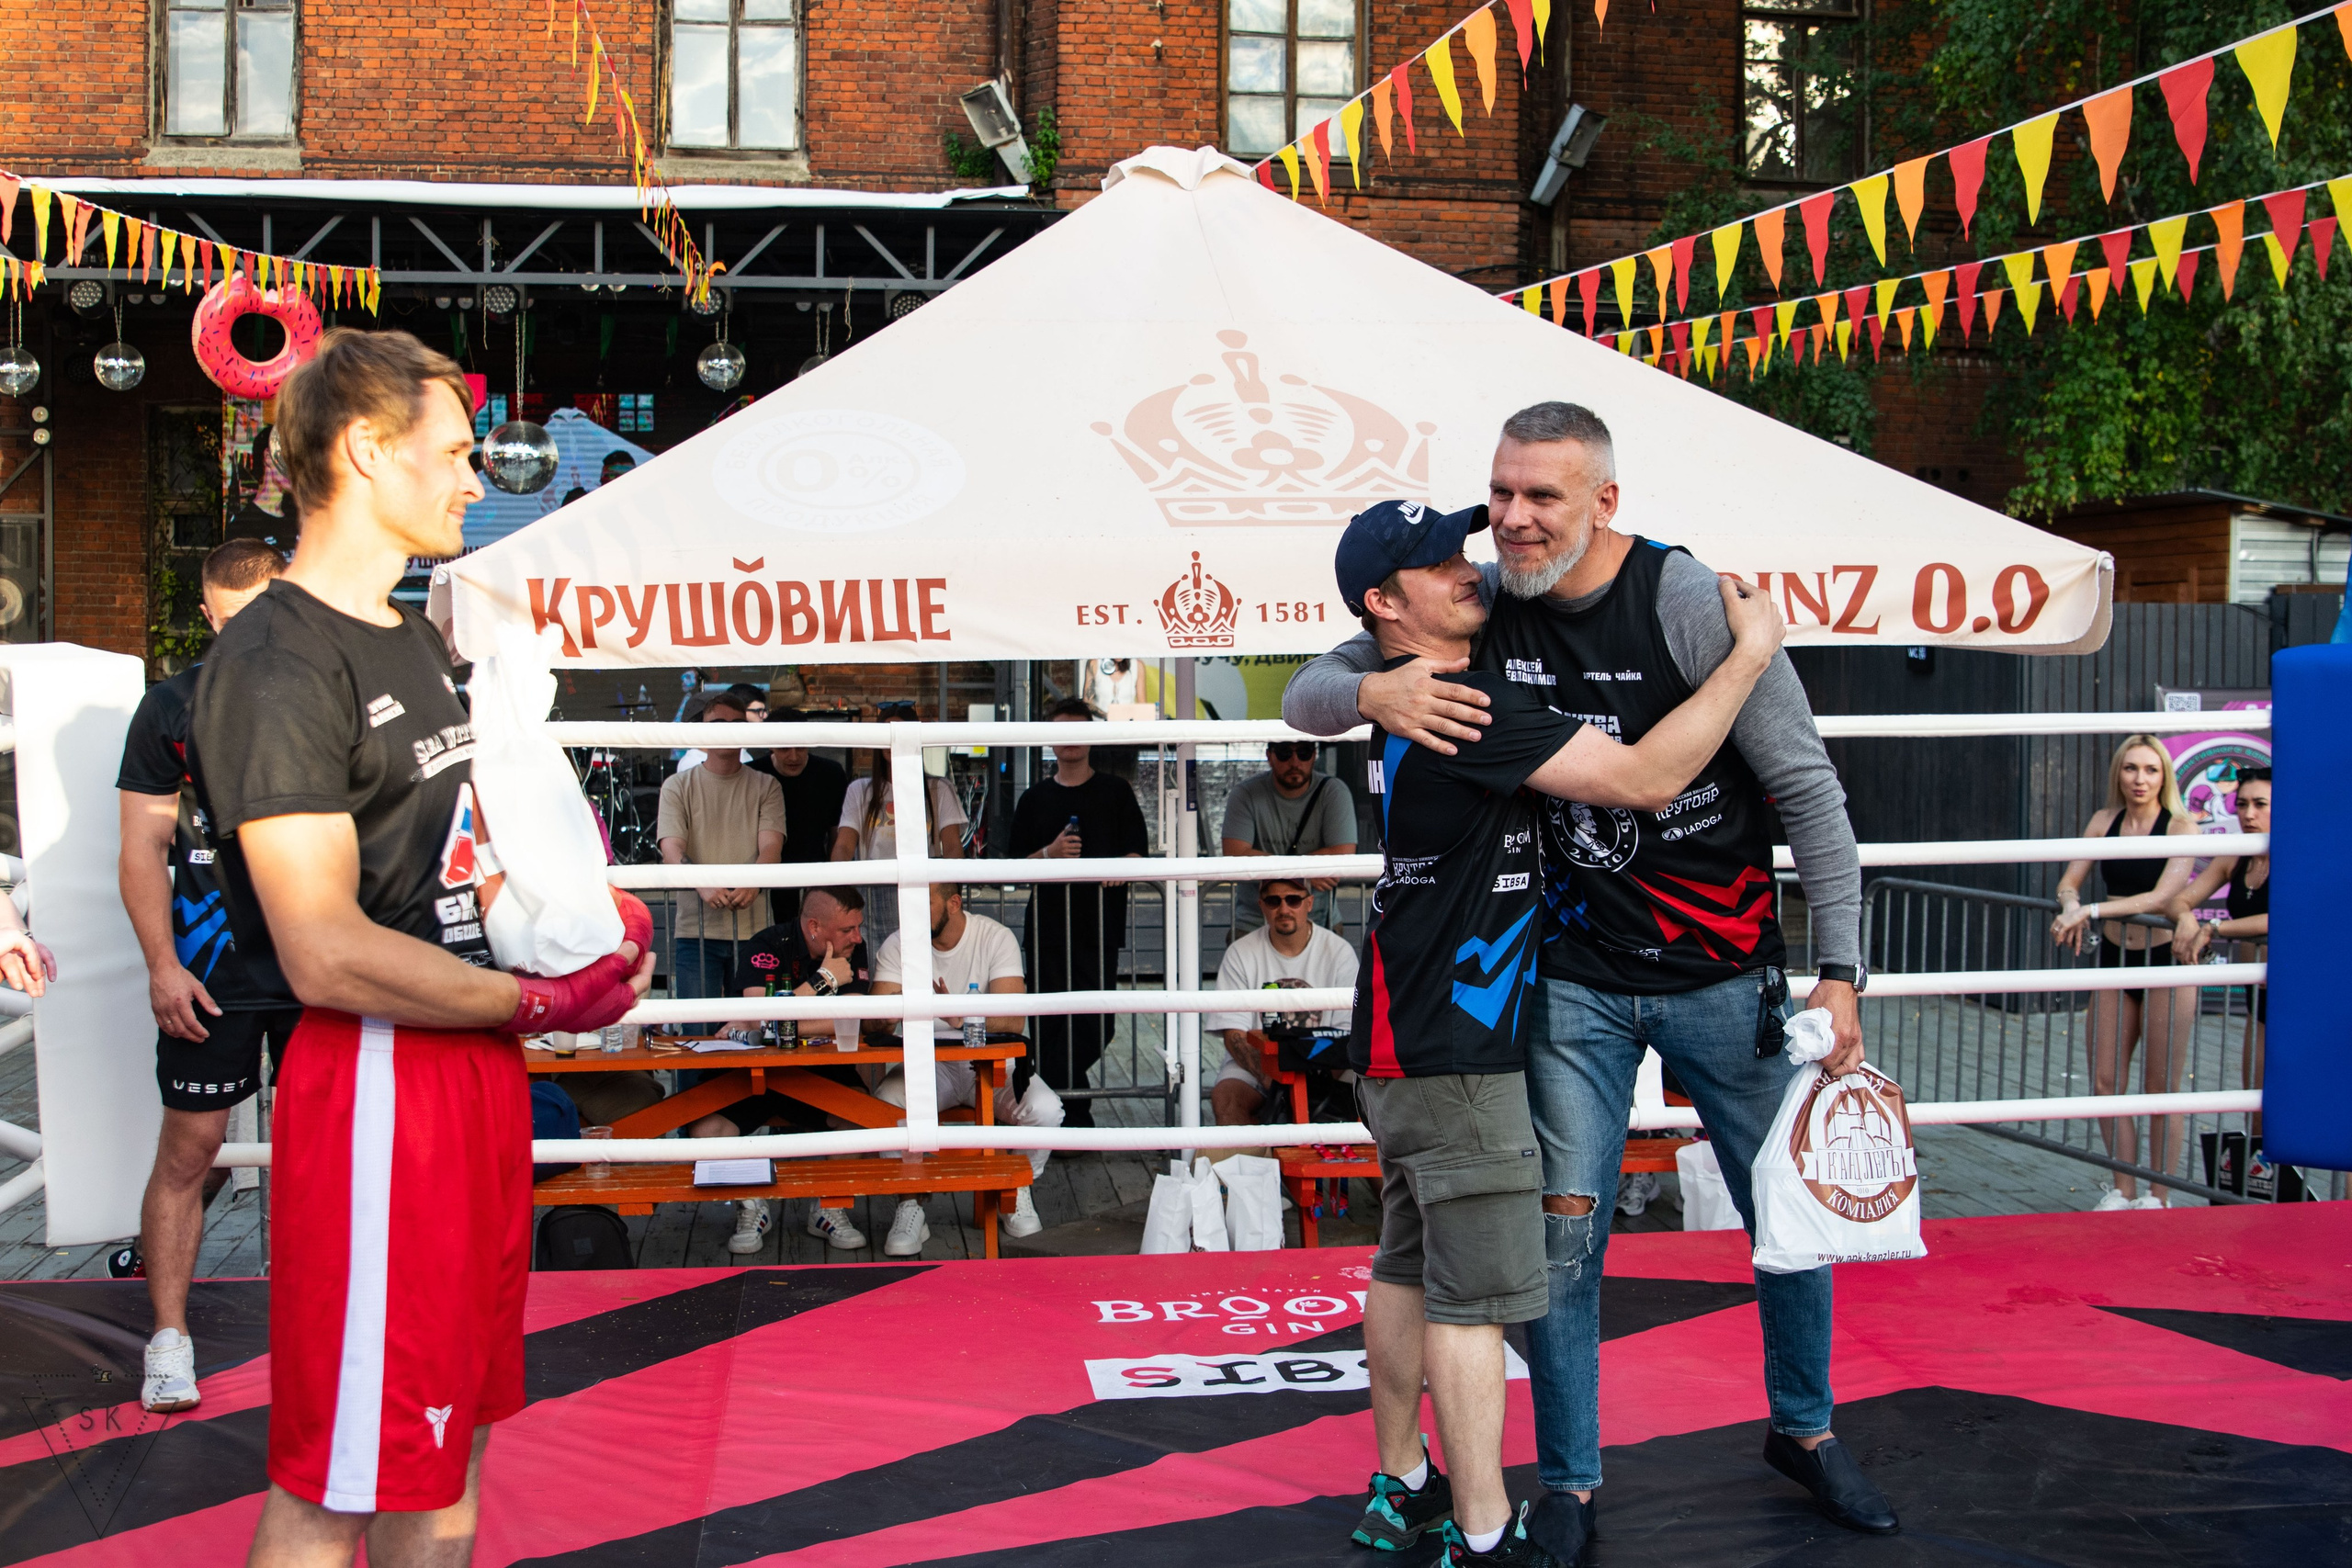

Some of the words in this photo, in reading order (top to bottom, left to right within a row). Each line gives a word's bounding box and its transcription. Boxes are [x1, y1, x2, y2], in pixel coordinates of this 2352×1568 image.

[1911, 561, 2051, 635] 0.0
[1076, 604, 1143, 626] EST.
[1255, 602, 1326, 624] 1581
[1615, 669, 1643, 682] ЧАЙКА
[1683, 813, 1723, 836] LADOGA
[1568, 848, 1623, 869] 2010
[172, 1077, 248, 1094] VESET
[1221, 1320, 1325, 1336] GIN
[1120, 1359, 1370, 1389] SIB
